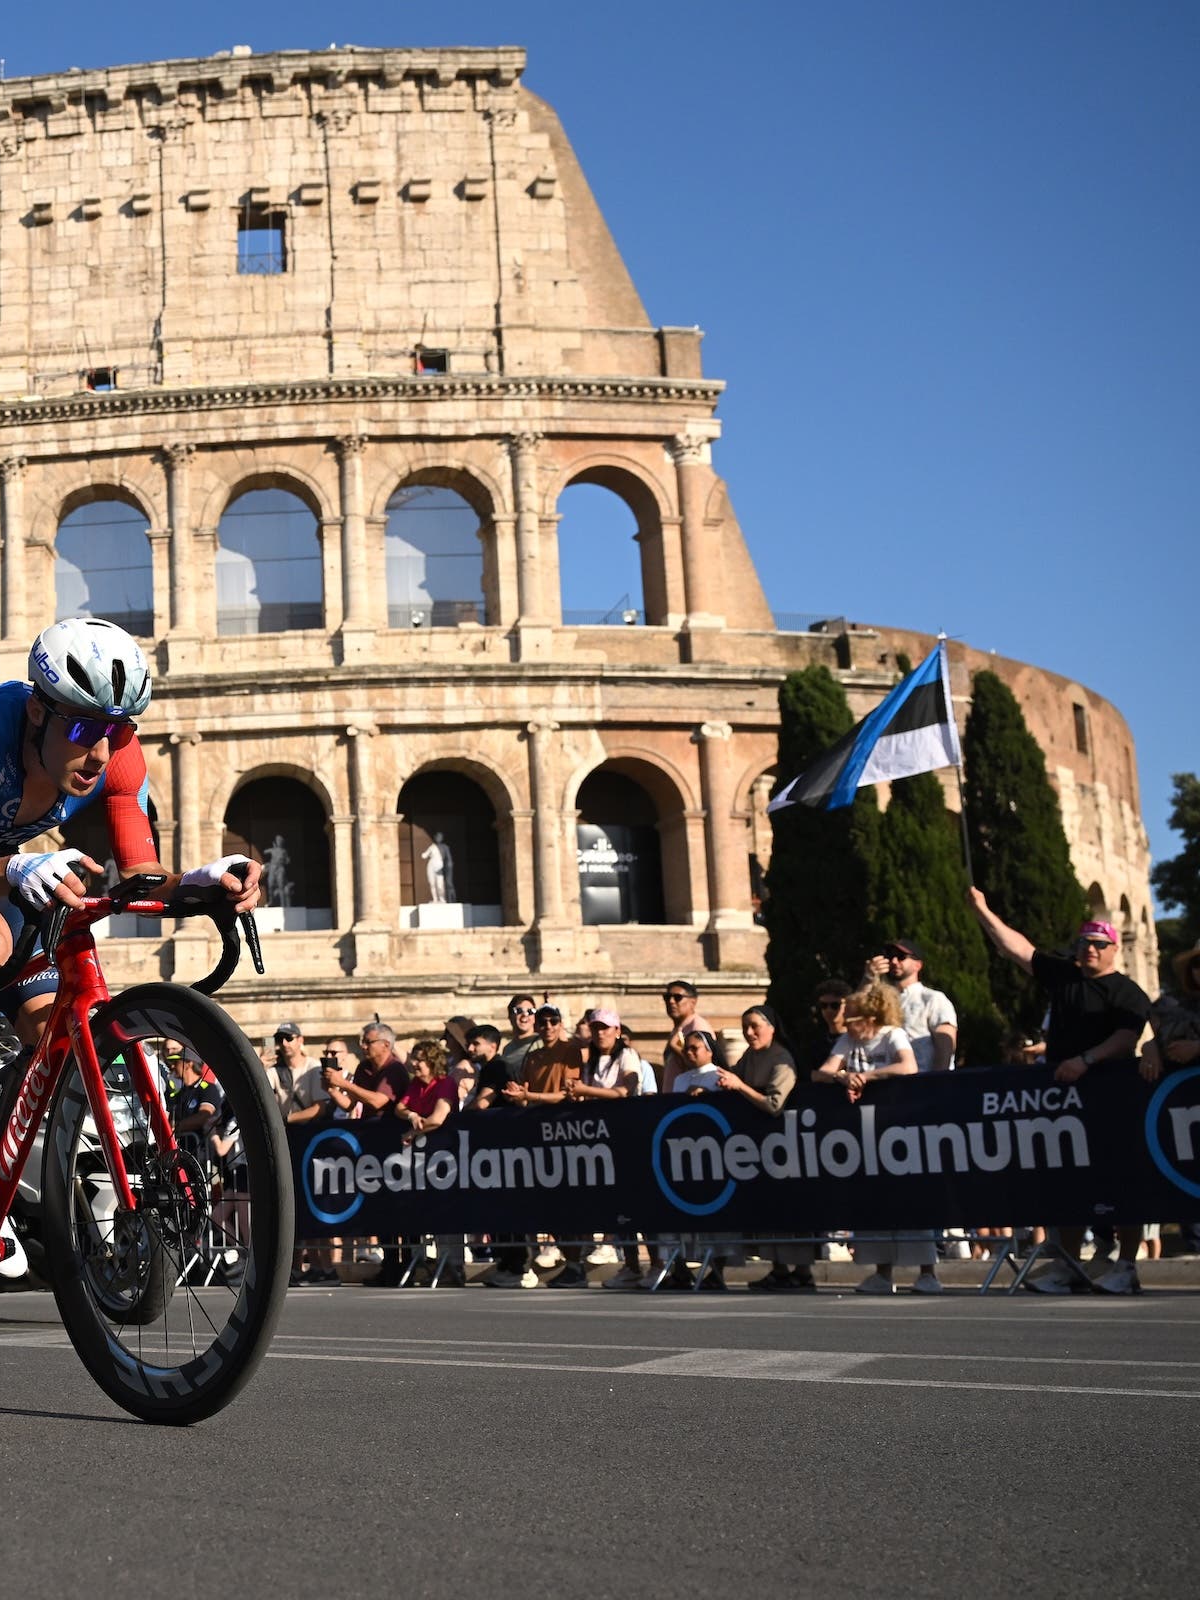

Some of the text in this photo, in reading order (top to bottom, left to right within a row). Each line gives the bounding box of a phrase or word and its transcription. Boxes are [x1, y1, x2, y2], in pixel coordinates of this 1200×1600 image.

[31, 641, 59, 684] ulbo
[982, 1086, 1083, 1115] BANCA
[541, 1119, 610, 1141] BANCA
[667, 1105, 1090, 1182] mediolanum
[312, 1130, 616, 1195] mediolanum
